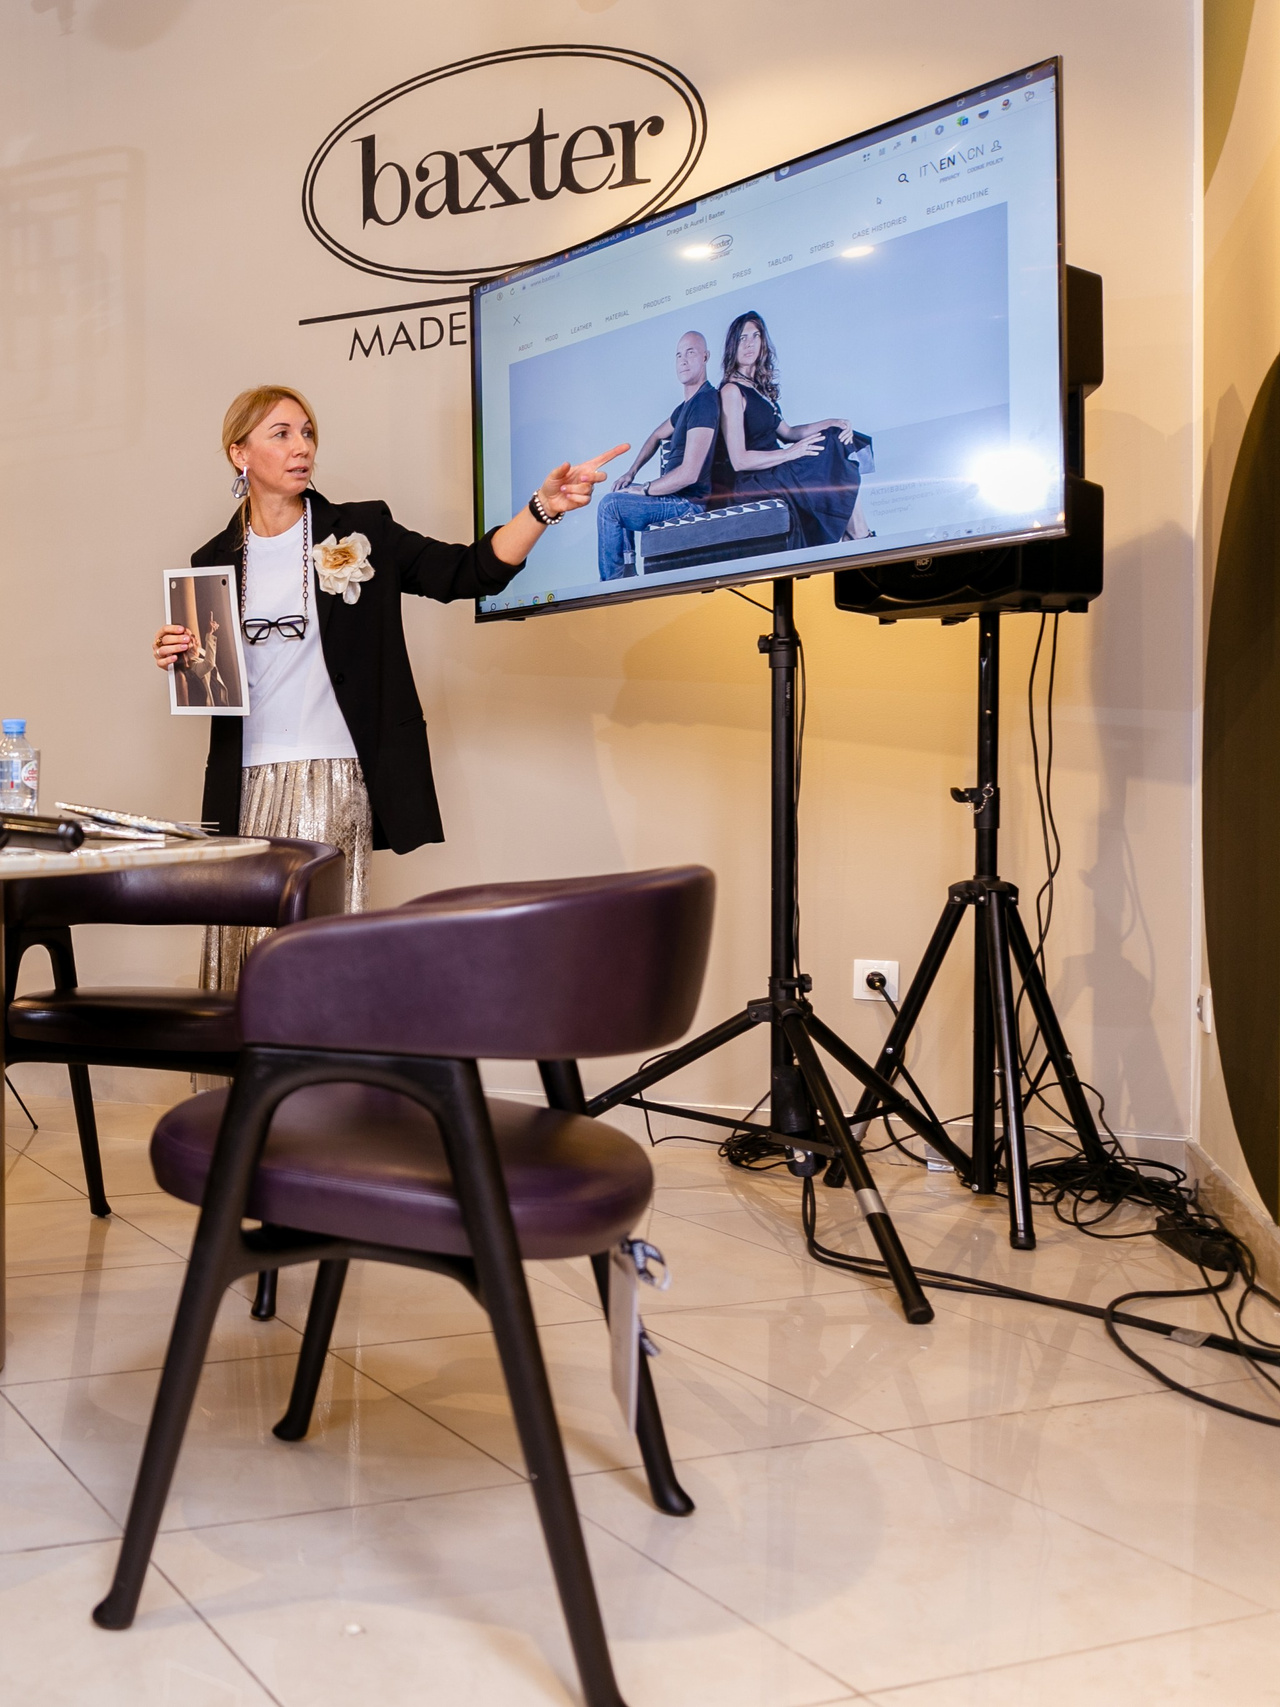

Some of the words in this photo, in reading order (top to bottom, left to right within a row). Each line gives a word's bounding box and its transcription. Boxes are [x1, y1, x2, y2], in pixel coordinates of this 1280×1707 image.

[350, 107, 665, 231] baxter
[938, 171, 961, 184] PRIVACY
[985, 156, 1004, 168] POLICY
[926, 199, 955, 215] BEAUTY
[956, 187, 990, 204] ROUTINE
[666, 225, 683, 237] Draga
[689, 217, 705, 228] Aurel
[708, 209, 726, 221] Baxter
[851, 226, 870, 240] CASE
[871, 215, 908, 233] HISTORIES
[809, 240, 835, 254] STORES
[768, 254, 793, 268] TABLOID
[732, 268, 752, 279] PRESS
[685, 279, 718, 296] DESIGNERS
[643, 295, 672, 310] PRODUCTS
[605, 309, 630, 323] MATERIAL
[348, 311, 468, 361] MADE
[570, 322, 593, 335] LEATHER
[544, 333, 559, 343] MOOD
[518, 341, 534, 352] ABOUT
[870, 481, 916, 497] Активация
